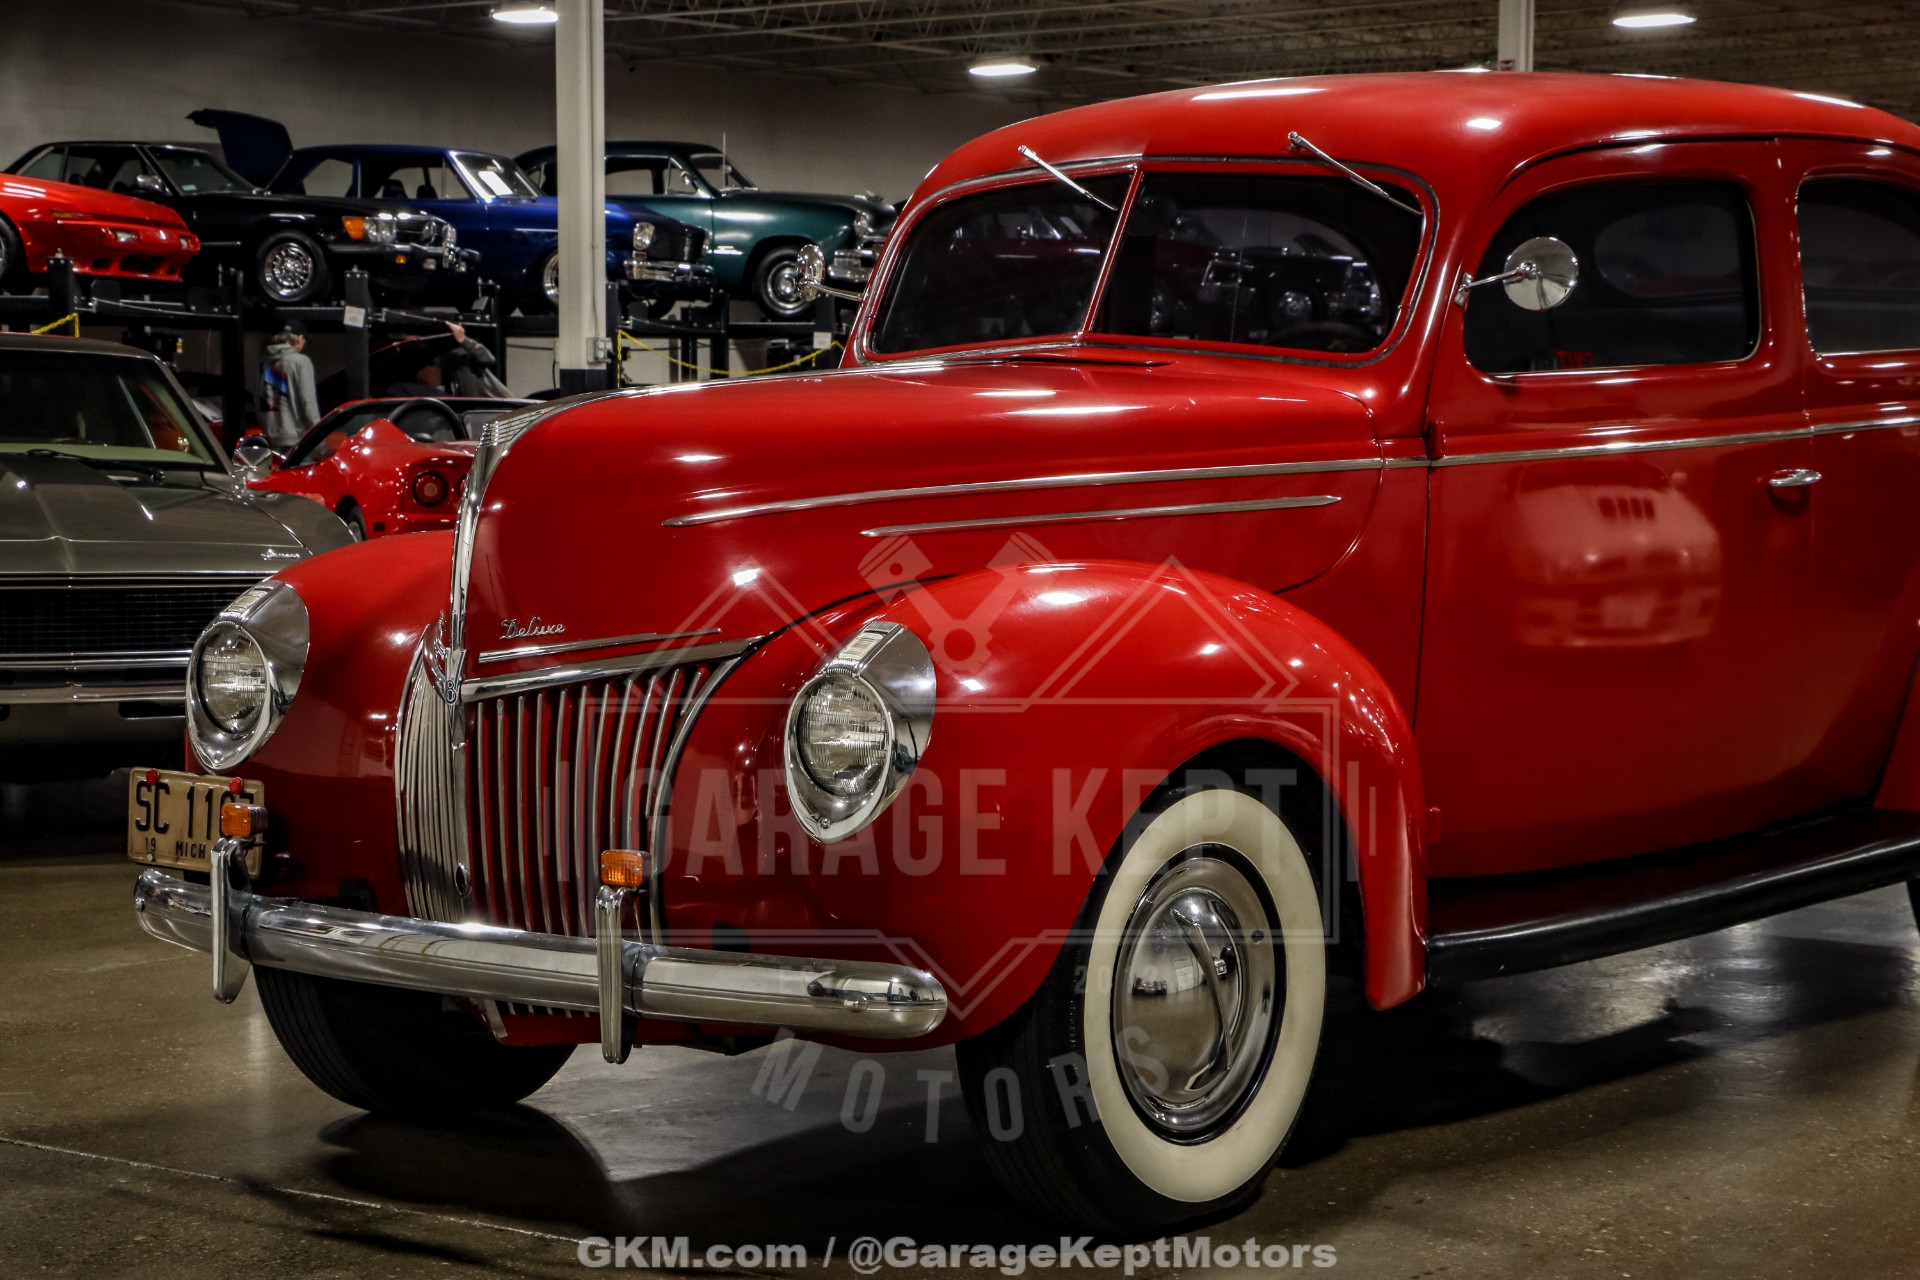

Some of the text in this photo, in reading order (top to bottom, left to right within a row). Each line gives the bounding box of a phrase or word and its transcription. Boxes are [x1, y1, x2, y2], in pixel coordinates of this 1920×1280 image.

[135, 780, 170, 834] SC
[145, 837, 156, 851] 19
[175, 840, 206, 859] MICH
